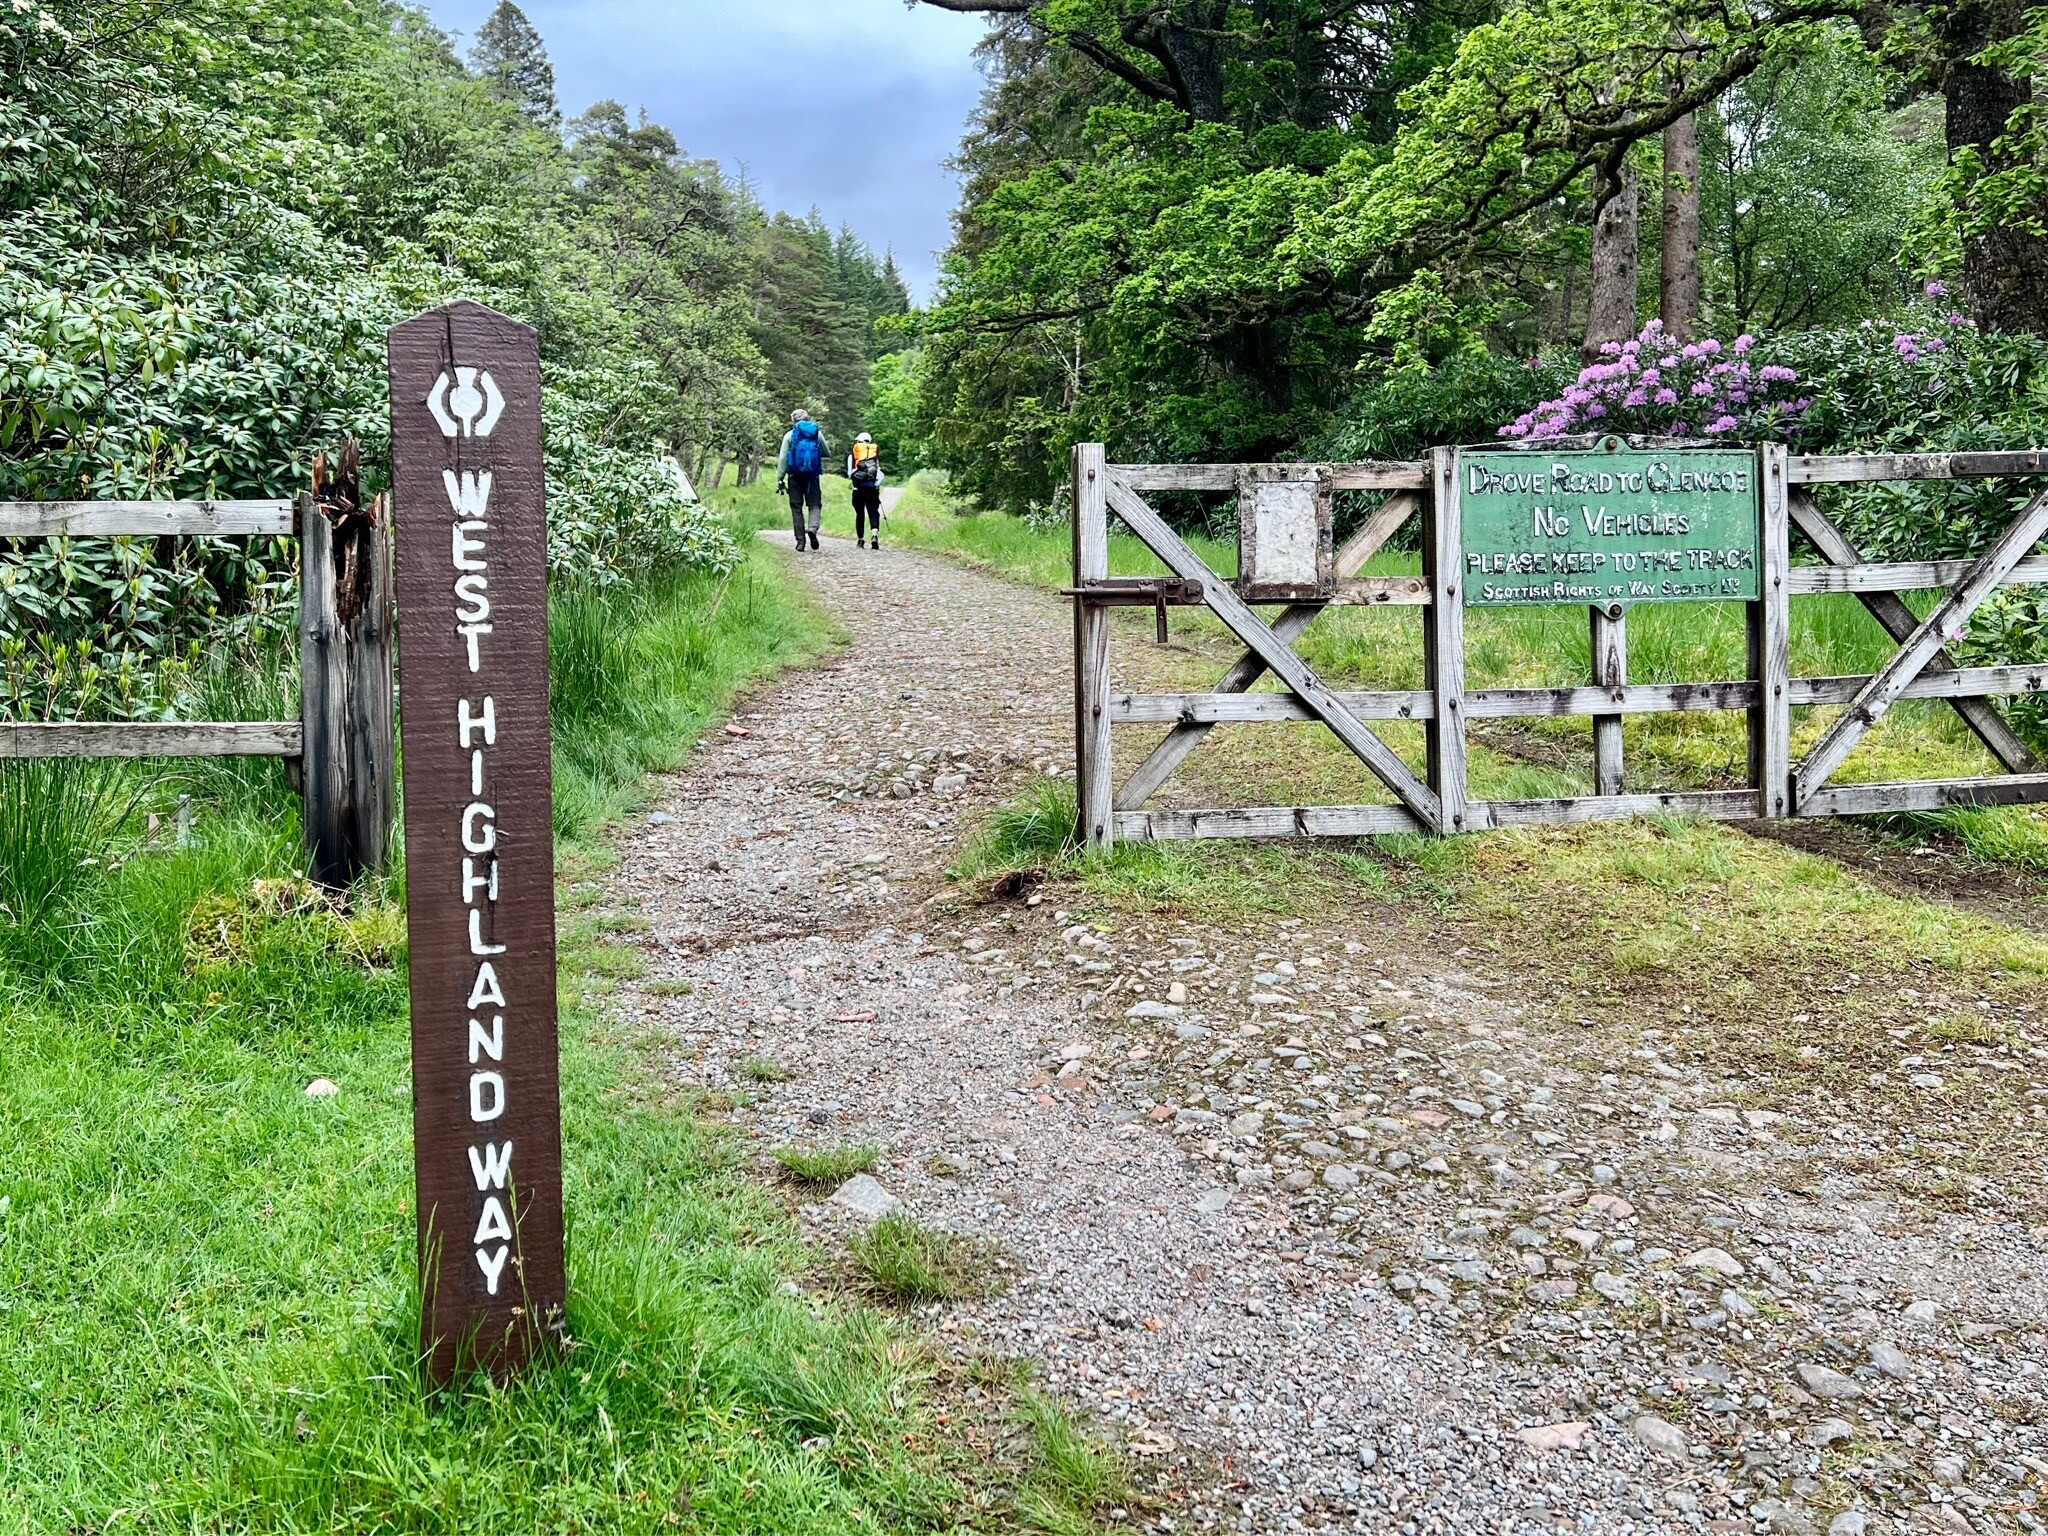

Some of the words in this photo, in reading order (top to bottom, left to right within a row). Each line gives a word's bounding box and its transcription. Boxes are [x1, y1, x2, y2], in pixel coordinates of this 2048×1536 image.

[1468, 464, 1545, 495] DROVE
[1550, 463, 1614, 495] ROAD
[1616, 471, 1643, 493] TO
[1646, 461, 1749, 493] GLENCOE
[1533, 506, 1570, 536] NO
[1581, 505, 1690, 537] VEHICLES
[442, 468, 493, 673] WEST
[1466, 552, 1548, 575] PLEASE
[1552, 552, 1607, 575] KEEP
[1611, 552, 1637, 572] TO
[1639, 550, 1683, 572] THE
[1686, 547, 1755, 571] TRACK
[1483, 581, 1550, 600] SCOTTISH
[1553, 581, 1602, 598] RIGHTS
[1608, 584, 1624, 596] OF
[1627, 580, 1656, 596] WAY
[1661, 579, 1717, 596] SOCIETY
[457, 695, 507, 1123] HIGHLAND
[468, 1140, 513, 1296] WAY
